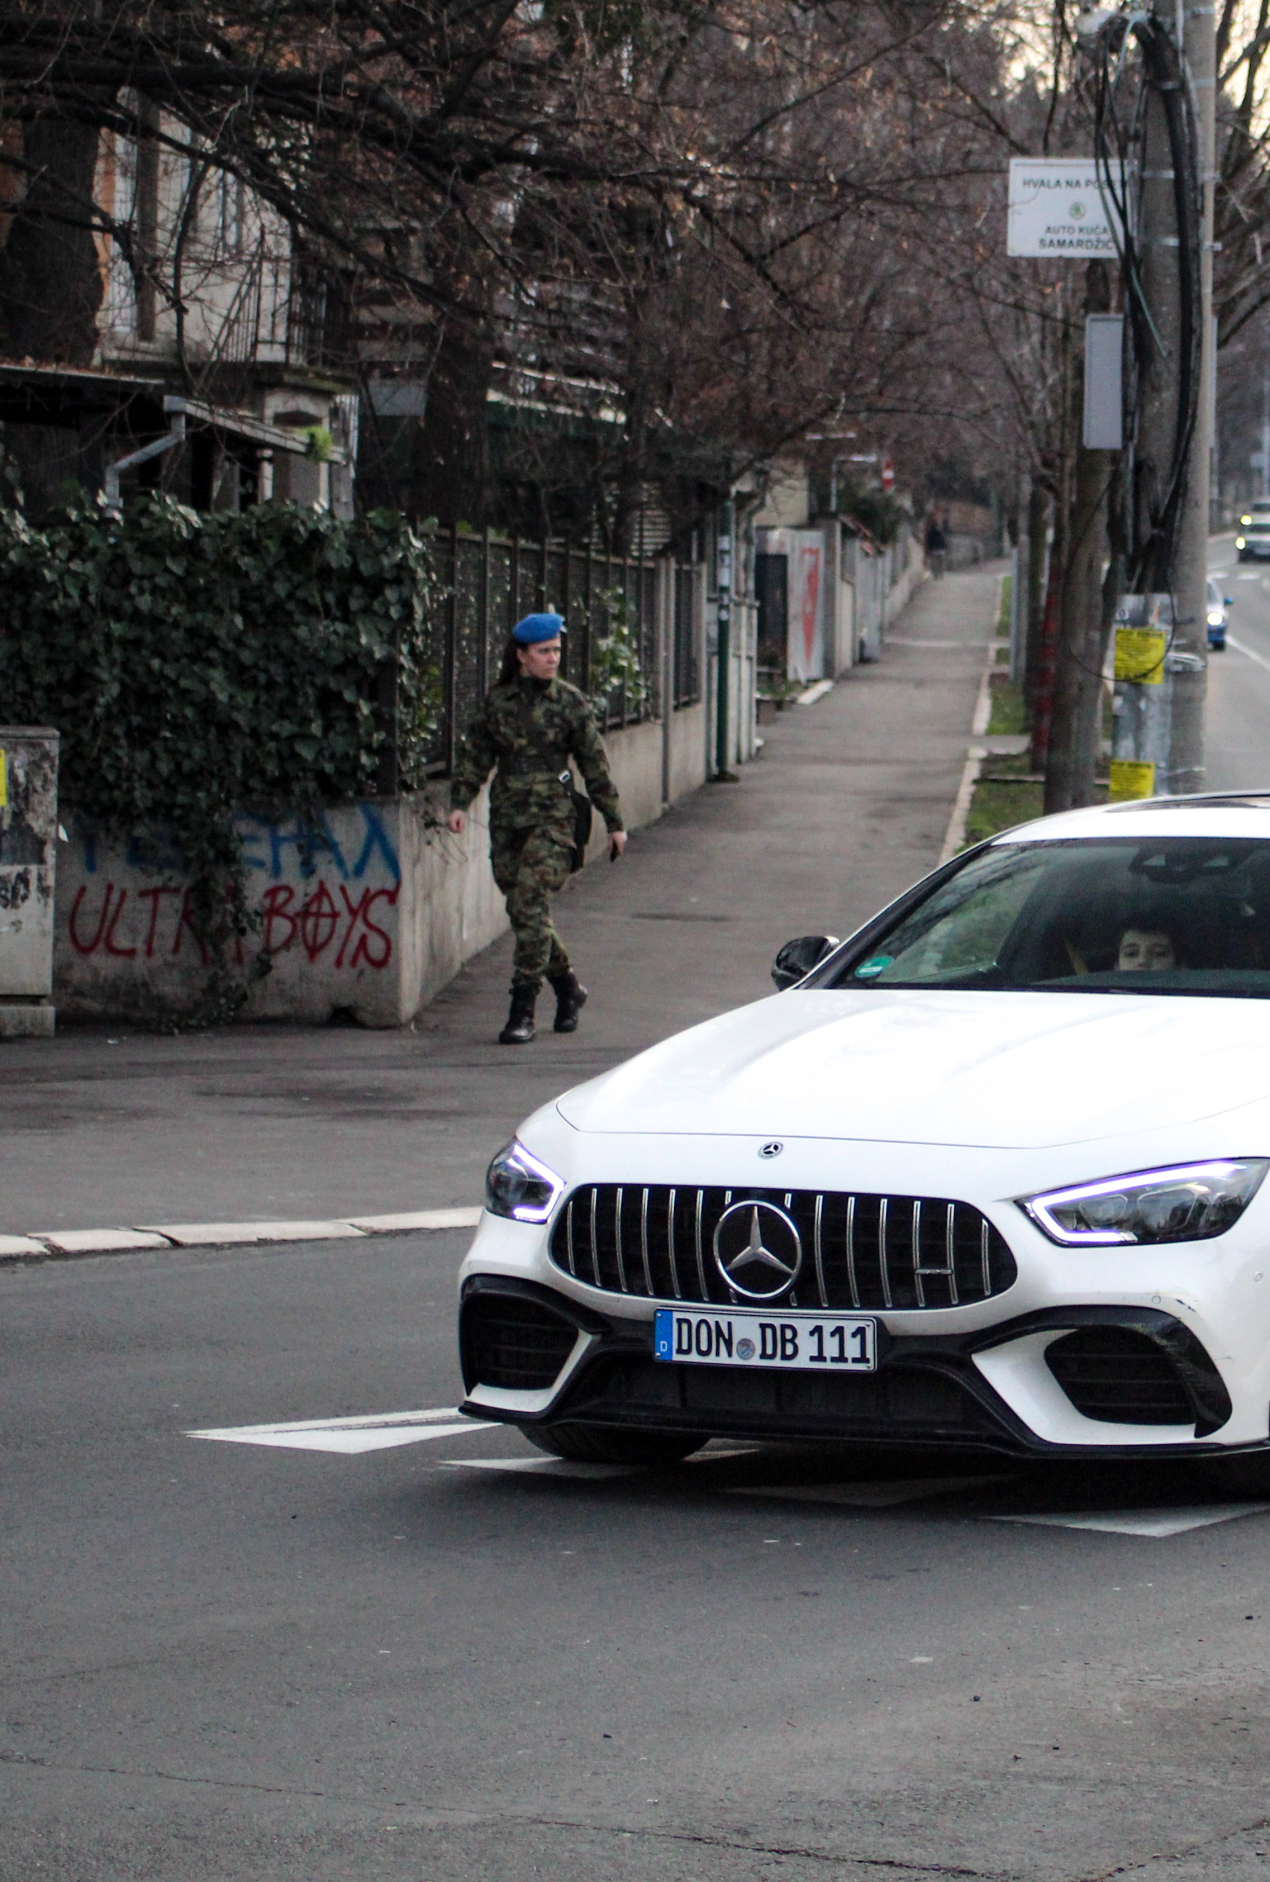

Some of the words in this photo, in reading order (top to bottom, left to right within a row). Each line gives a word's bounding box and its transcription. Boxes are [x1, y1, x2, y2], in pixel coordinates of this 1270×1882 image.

[1023, 180, 1062, 189] HVALA
[1066, 180, 1081, 189] NA
[1046, 226, 1075, 235] AUTO
[675, 1317, 733, 1358] DON
[759, 1322, 799, 1361] DB
[808, 1324, 871, 1364] 111
[660, 1340, 668, 1352] D
